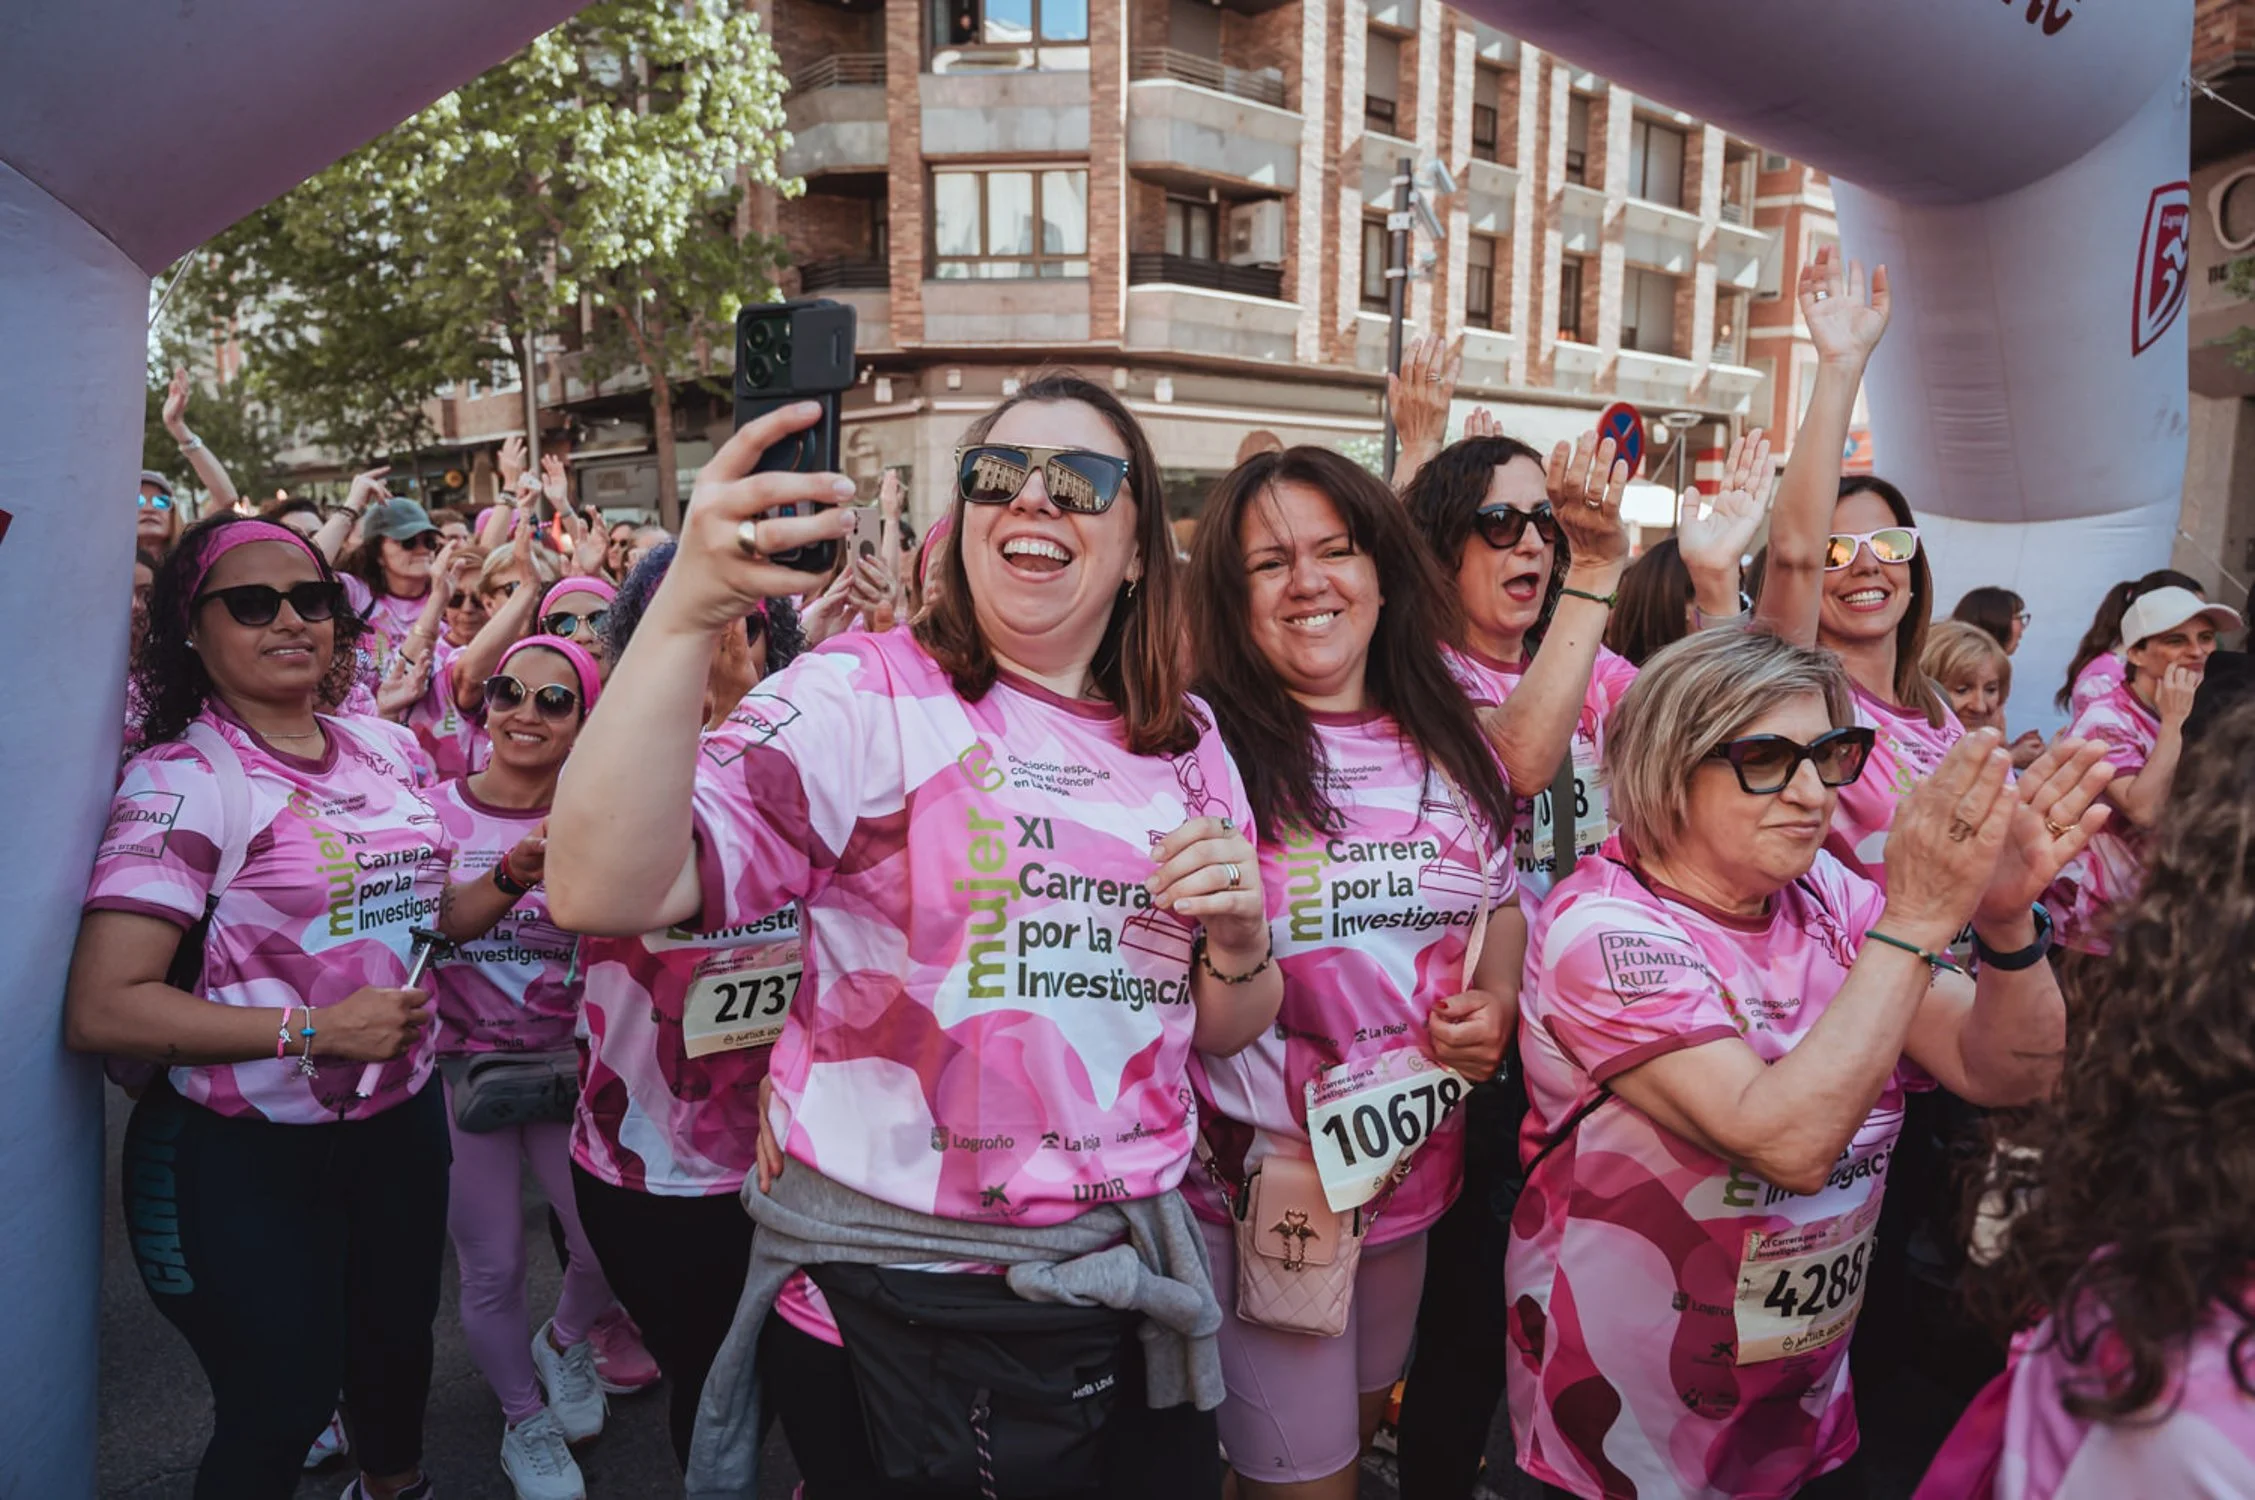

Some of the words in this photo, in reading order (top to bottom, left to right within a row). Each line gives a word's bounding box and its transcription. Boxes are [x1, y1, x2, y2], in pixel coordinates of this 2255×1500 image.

[1015, 816, 1054, 849] XI
[355, 845, 432, 871] Carrera
[1326, 838, 1439, 863] Carrera
[308, 825, 361, 937] mujer
[359, 879, 393, 906] por
[394, 872, 412, 892] la
[1019, 862, 1152, 911] Carrera
[1277, 818, 1329, 942] muje
[1332, 873, 1381, 909] por
[1388, 871, 1413, 898] la
[359, 896, 439, 931] Investigac
[954, 807, 1021, 998] mujer
[1018, 920, 1080, 957] por
[1088, 917, 1112, 954] la
[1332, 903, 1496, 938] Investigaci
[1018, 962, 1190, 1012] Investigaci
[1618, 969, 1668, 990] RUIZ
[953, 1134, 1014, 1152] Logroño
[1065, 1137, 1081, 1152] La
[1764, 1242, 1865, 1317] 4288
